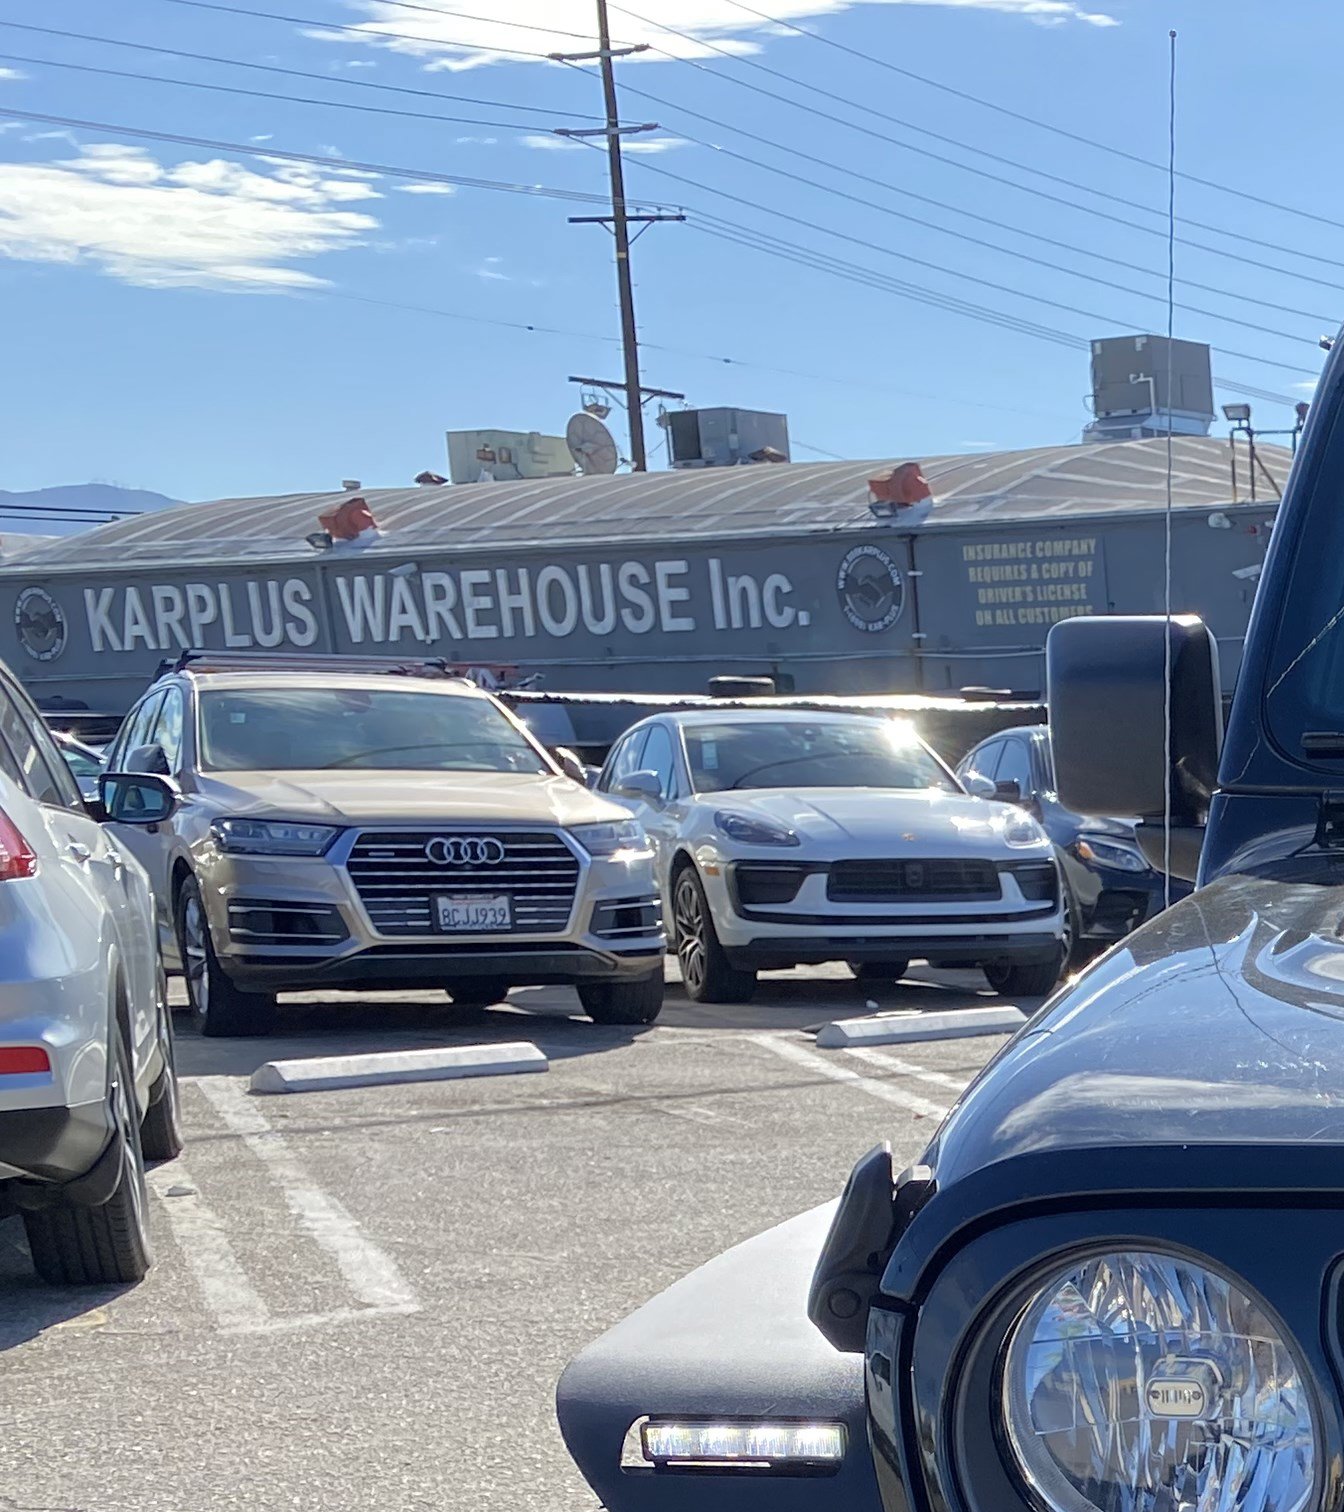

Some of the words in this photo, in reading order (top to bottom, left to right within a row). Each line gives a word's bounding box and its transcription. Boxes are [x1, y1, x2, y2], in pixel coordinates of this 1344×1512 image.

[963, 542, 1033, 560] INSURANCE
[1035, 538, 1096, 557] COMPANY
[968, 564, 1027, 583] REQUIRES
[1031, 564, 1039, 579] A
[1042, 561, 1075, 579] COPY
[1078, 561, 1093, 577] OF
[83, 578, 319, 651] KARPLUS
[335, 559, 696, 643] WAREHOUSE
[708, 558, 810, 629] Inc.
[977, 586, 1034, 604] DRIVER'S
[1036, 584, 1087, 601] LICENSE
[995, 609, 1016, 625] ALL
